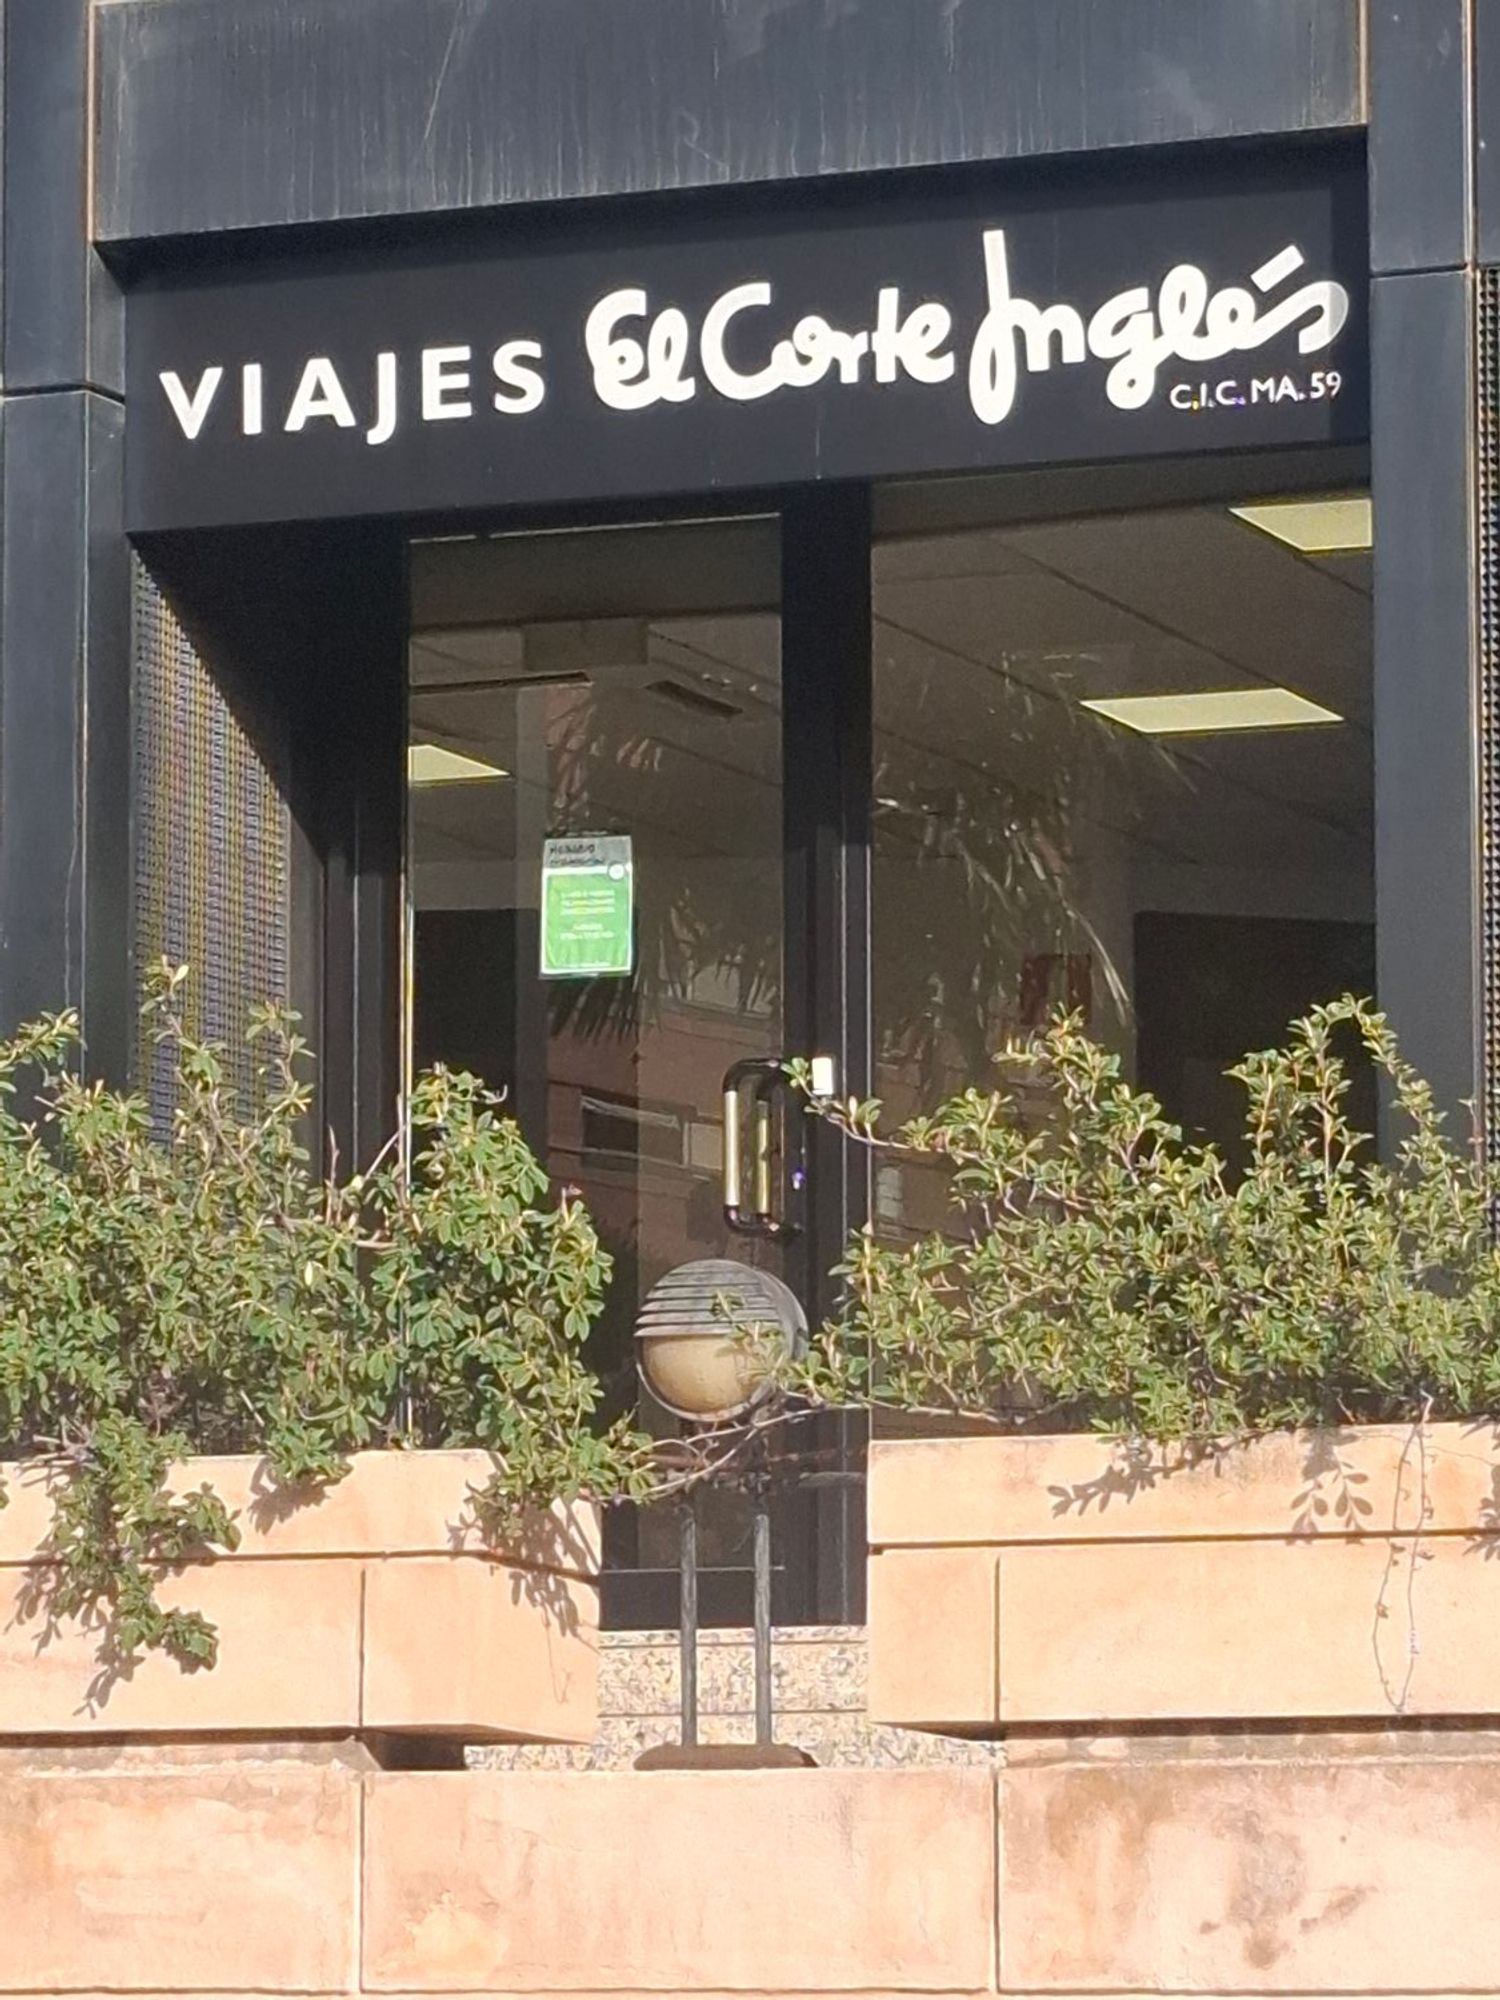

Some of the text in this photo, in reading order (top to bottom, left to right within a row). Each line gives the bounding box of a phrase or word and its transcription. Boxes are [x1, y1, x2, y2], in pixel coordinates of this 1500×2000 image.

[158, 228, 1349, 446] VIAJES El Corte Inglés
[1250, 374, 1306, 404] MA.
[1309, 371, 1342, 399] 59
